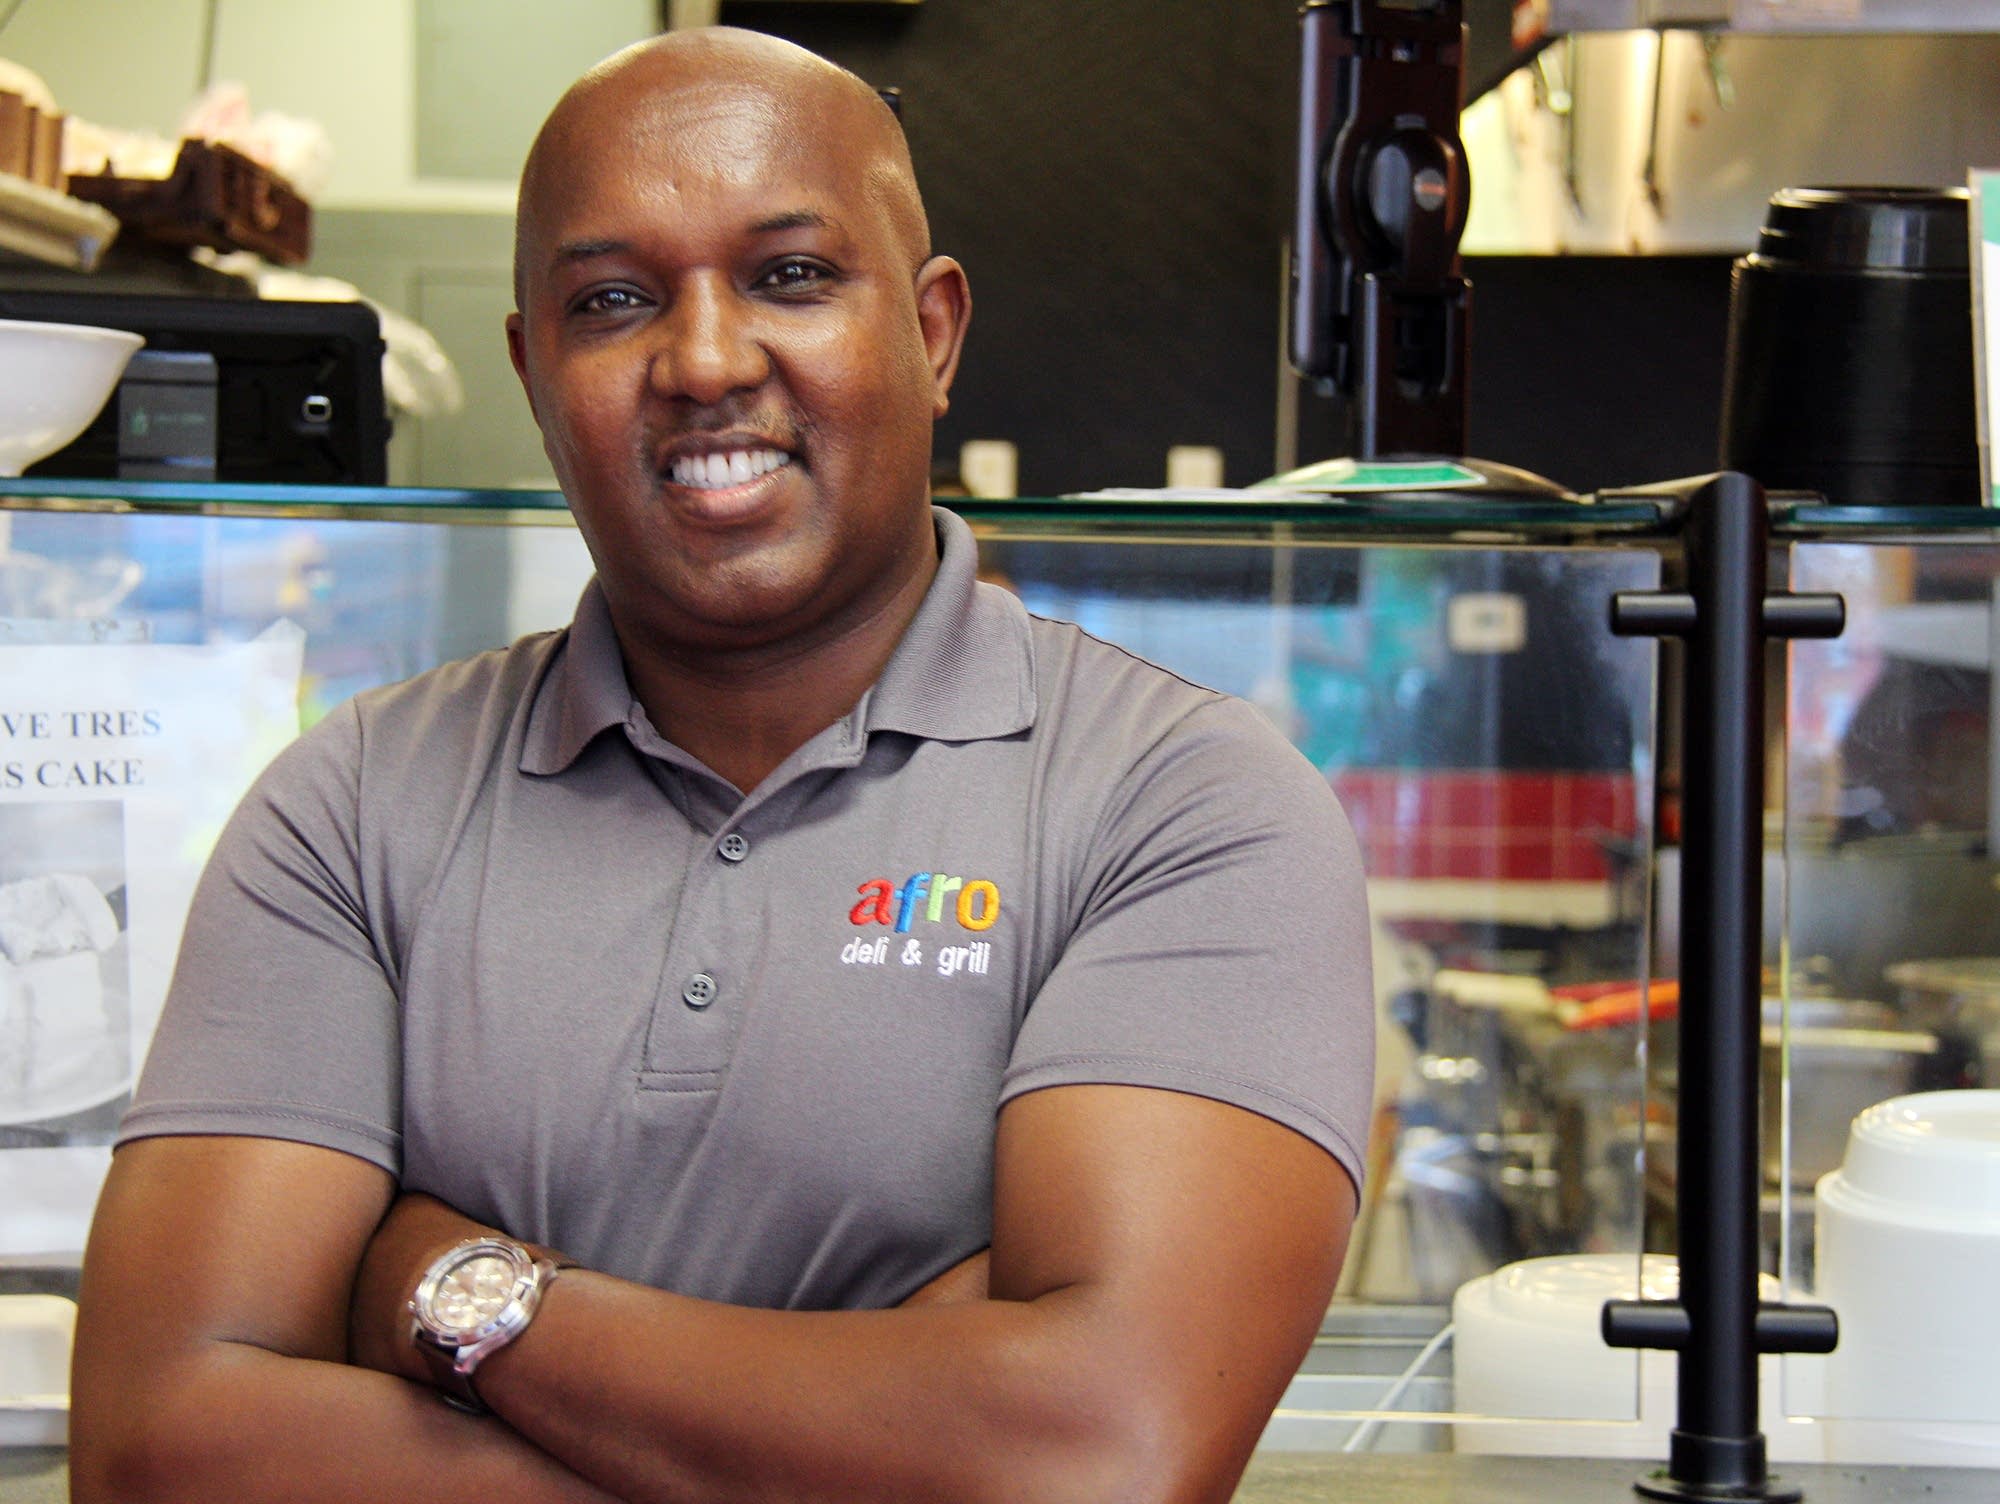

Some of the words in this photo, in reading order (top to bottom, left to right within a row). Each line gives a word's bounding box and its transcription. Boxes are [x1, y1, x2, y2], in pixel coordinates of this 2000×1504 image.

[61, 709, 161, 738] TRES
[36, 757, 145, 788] CAKE
[849, 871, 1000, 933] afro
[840, 936, 890, 965] deli
[900, 938, 922, 965] &
[936, 941, 991, 976] grill
